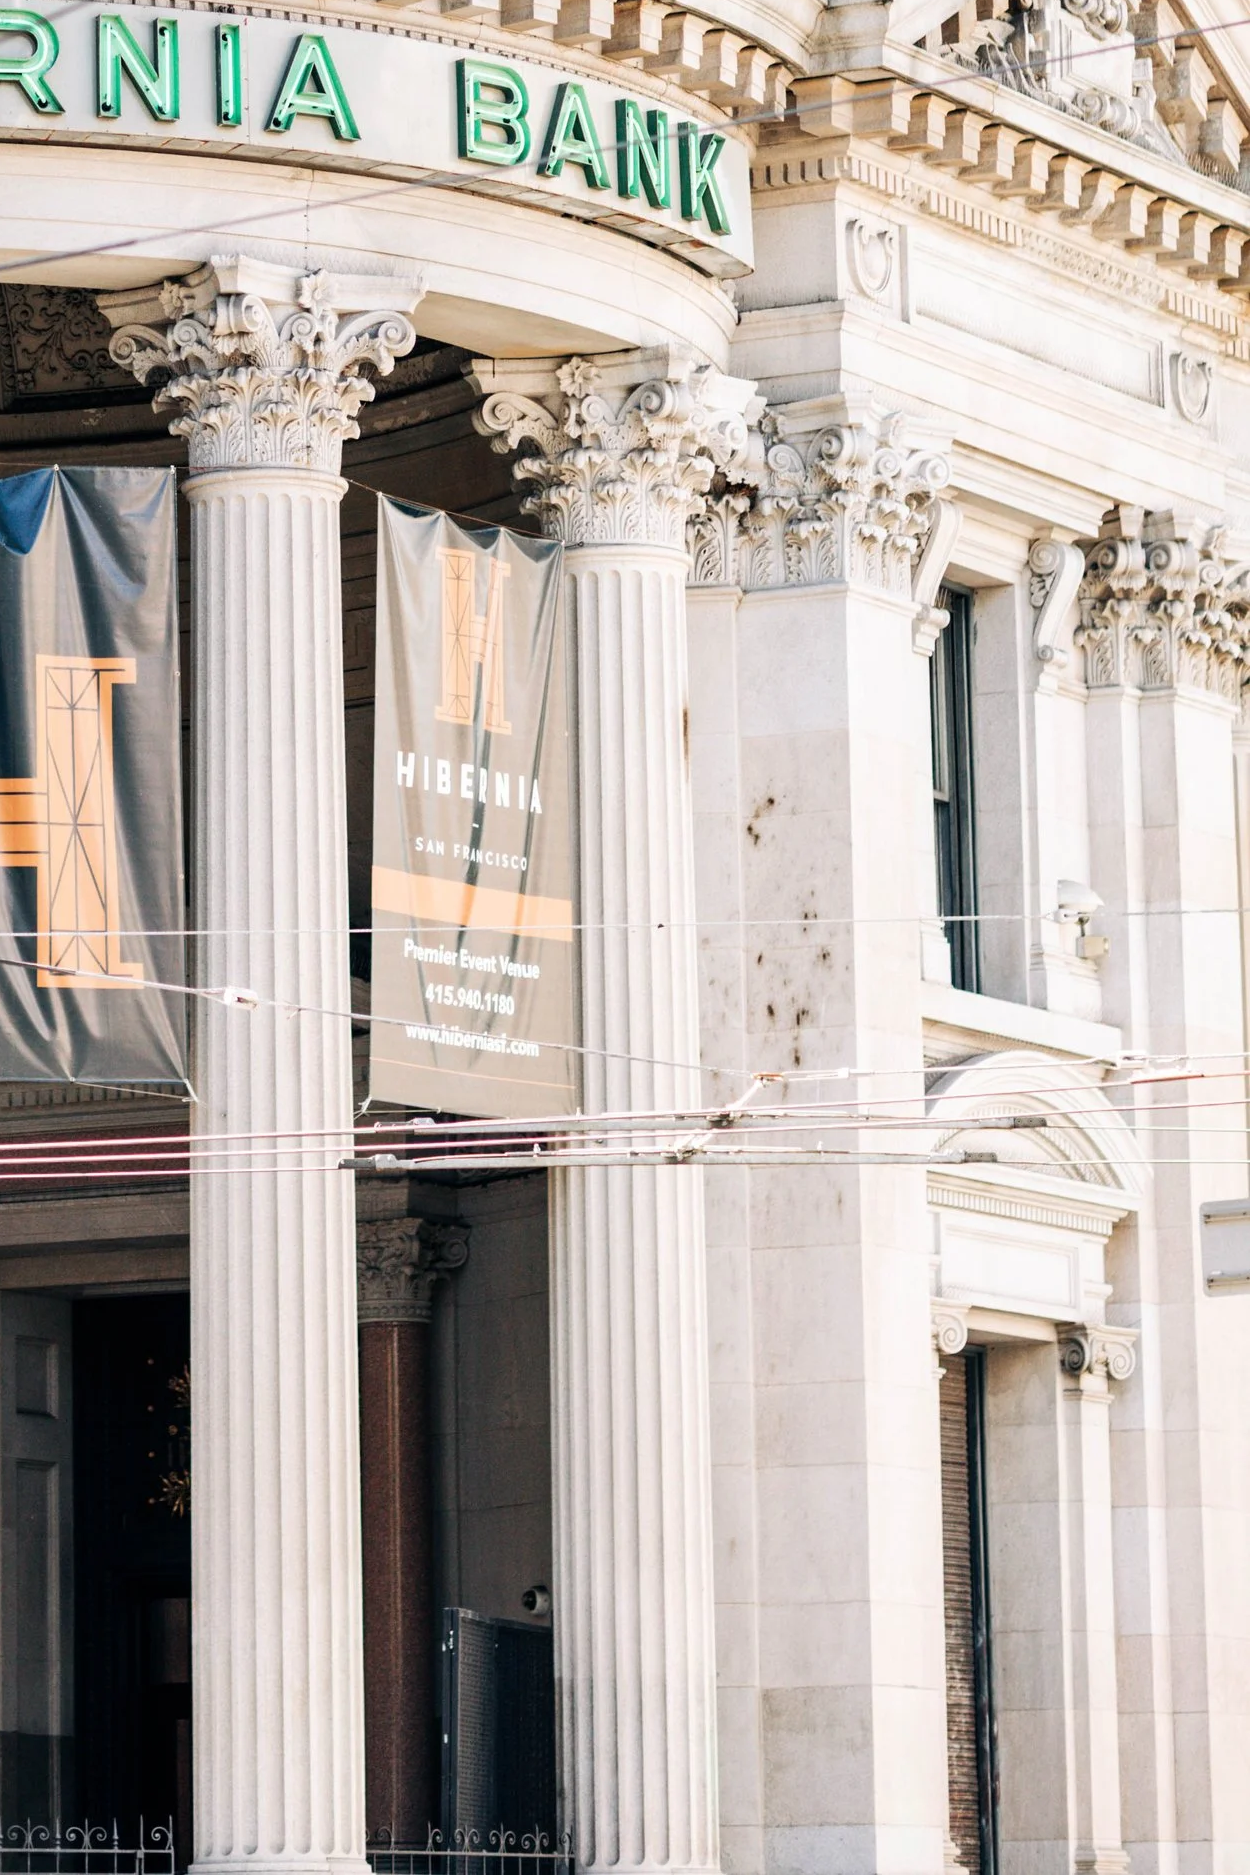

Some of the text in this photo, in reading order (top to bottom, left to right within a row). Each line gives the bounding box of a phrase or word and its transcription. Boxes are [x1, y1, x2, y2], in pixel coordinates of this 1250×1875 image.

[454, 57, 733, 236] BANK
[435, 545, 512, 736] H
[397, 750, 542, 814] HIBERNIA
[415, 836, 527, 871] SAN FRANCISCO
[403, 937, 540, 979] Premier Event Venue
[425, 982, 515, 1016] 415.940.1180
[405, 1023, 540, 1057] www.hiberniasf.com
